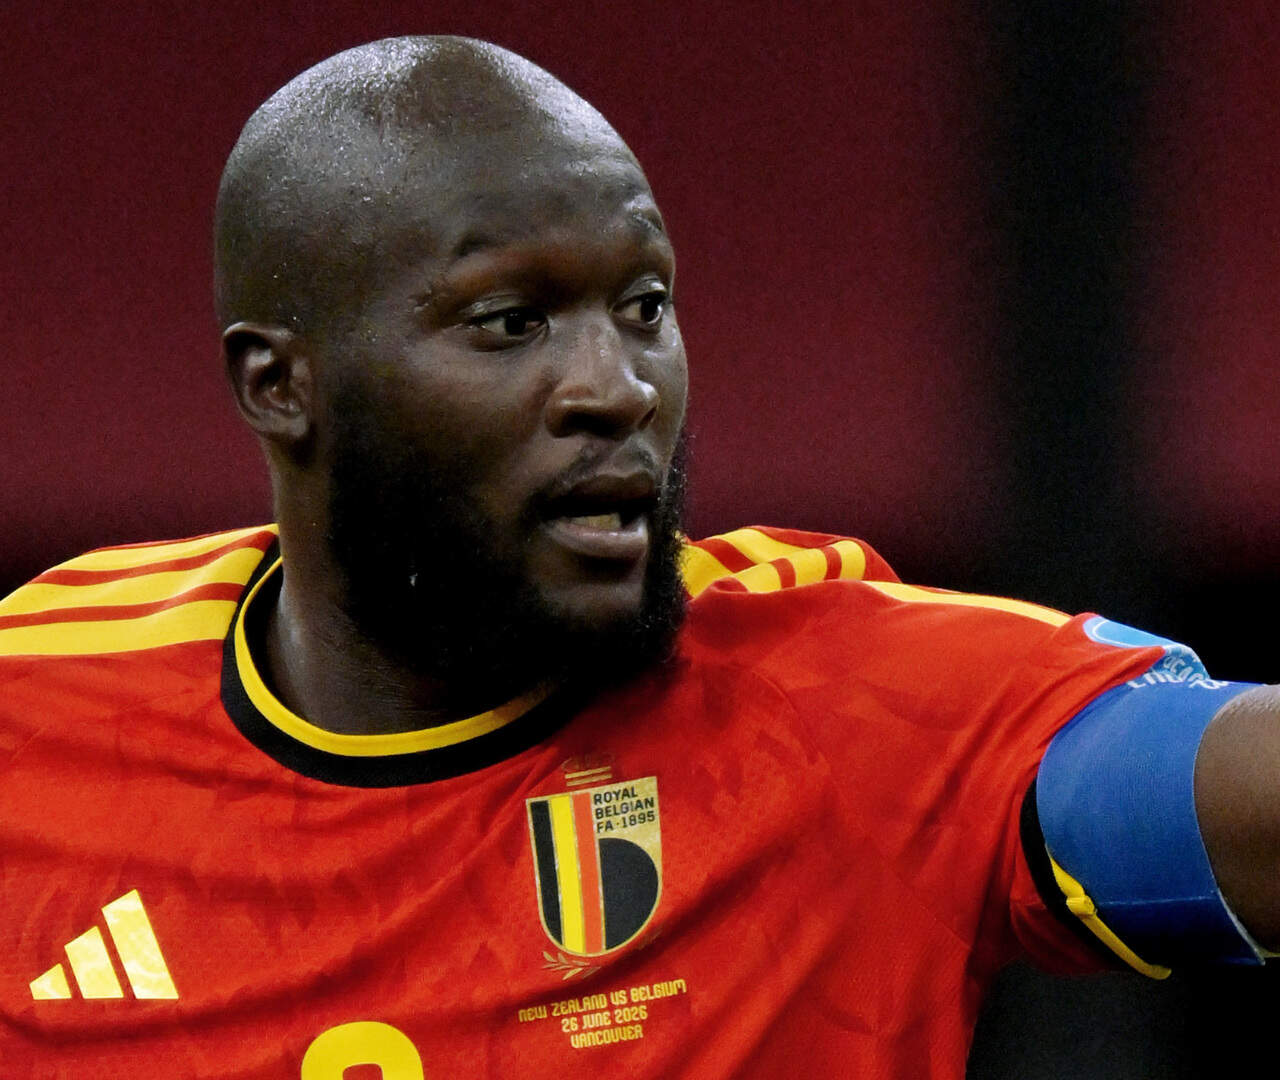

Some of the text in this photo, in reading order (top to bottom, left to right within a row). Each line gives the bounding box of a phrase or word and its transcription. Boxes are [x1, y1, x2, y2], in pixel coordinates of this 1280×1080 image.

[593, 786, 638, 805] ROYAL
[595, 797, 654, 820] BELGIAN
[551, 993, 608, 1017] ZEALAND
[630, 978, 687, 1003] BELGIUM
[561, 1016, 578, 1033] 26
[582, 1011, 612, 1030] JUNE
